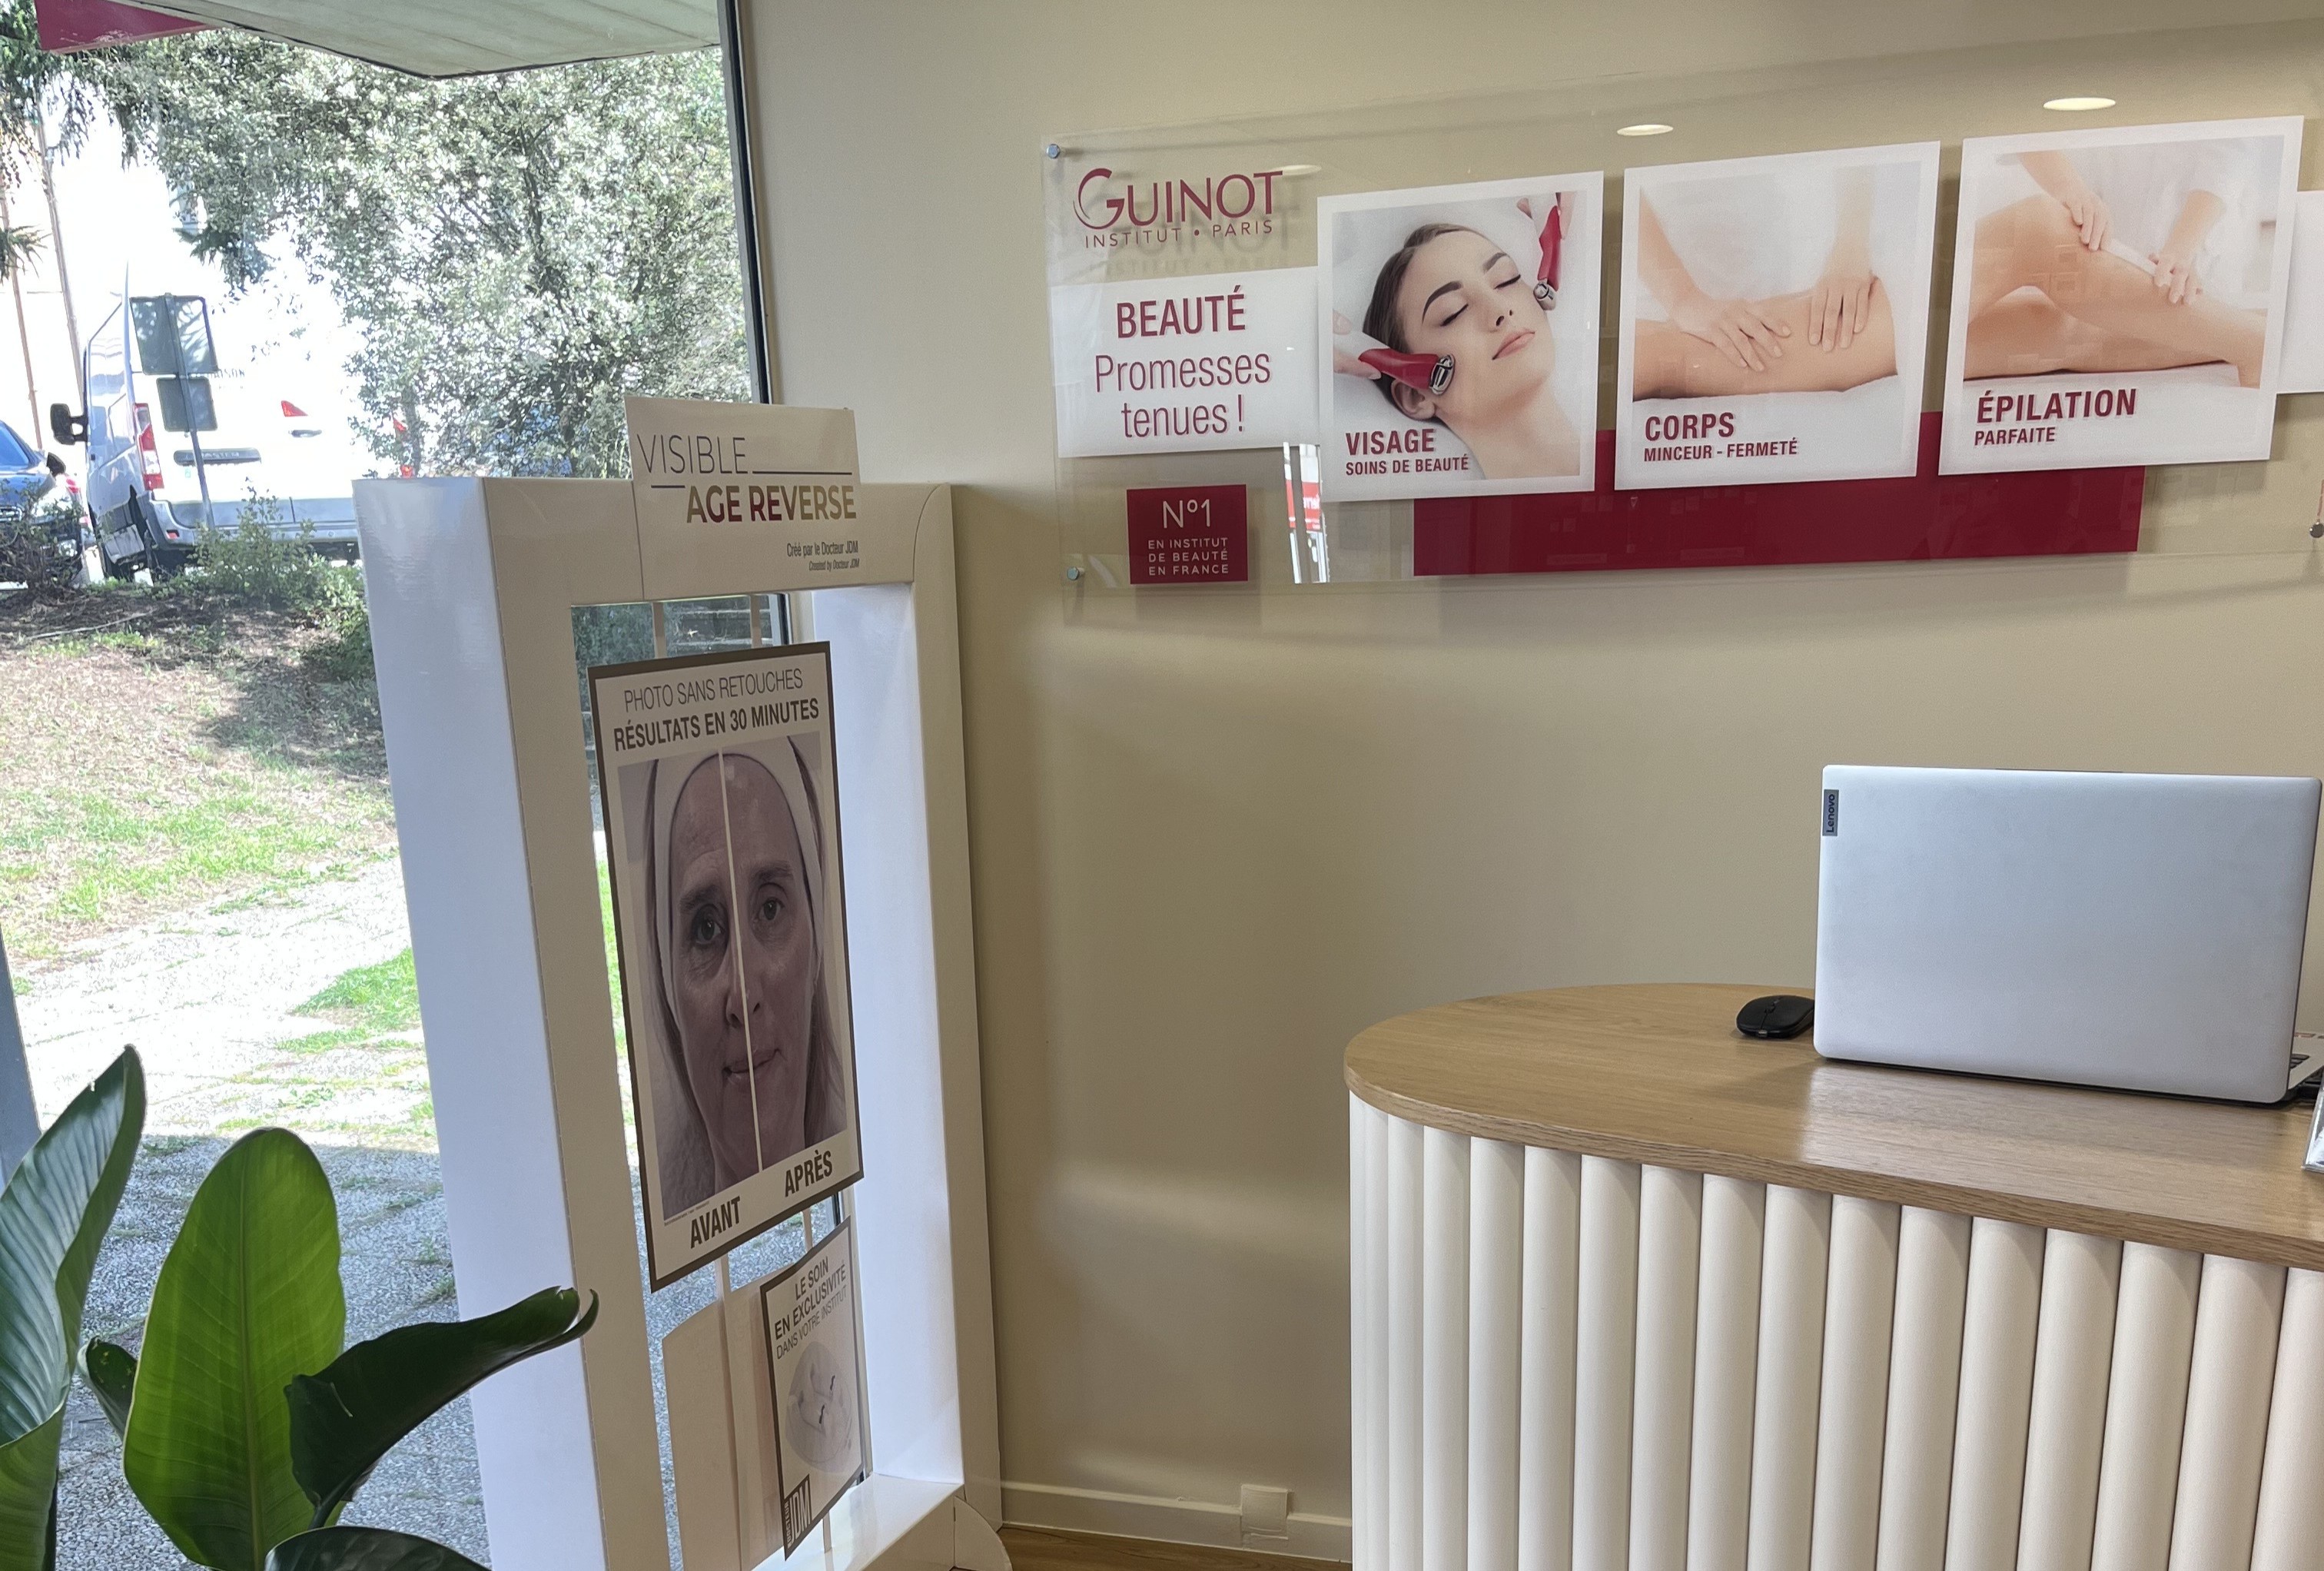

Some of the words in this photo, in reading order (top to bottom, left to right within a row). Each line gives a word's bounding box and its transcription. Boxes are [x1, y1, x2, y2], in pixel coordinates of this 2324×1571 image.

[1073, 168, 1283, 230] GUINOT
[1084, 227, 1182, 248] INSTITUT
[1212, 219, 1273, 238] PARIS
[1116, 284, 1246, 339] BEAUTÉ
[1095, 353, 1271, 393] Promesses
[1120, 402, 1228, 438] tenues
[1977, 390, 2137, 423] ÉPILATION
[1346, 428, 1435, 456] VISAGE
[1645, 412, 1735, 442] CORPS
[1974, 427, 2056, 447] PARFAITE
[636, 433, 749, 474] VISIBLE
[1346, 460, 1386, 476] SOINS
[1393, 459, 1409, 473] DE
[1416, 453, 1469, 472] BEAUTÉ
[1644, 444, 1712, 462] MINCEUR
[1727, 437, 1798, 458] FERMETÉ
[686, 485, 742, 523] AGE
[749, 485, 857, 522] REVERSE
[786, 541, 802, 557] Créé
[802, 544, 813, 559] par
[815, 542, 820, 556] le
[821, 541, 845, 555] Docteur
[845, 540, 858, 553] JDM
[1148, 540, 1164, 550] EN
[1170, 537, 1228, 549] INSTITUT
[1148, 553, 1166, 563] DE
[1173, 548, 1228, 562] BEAUTÉ
[1149, 566, 1166, 576] EN
[1173, 564, 1229, 575] FRANCE
[624, 684, 674, 712] PHOTO
[677, 679, 715, 705] SANS
[719, 668, 804, 699] RETOUCHES
[613, 715, 701, 752] RÉSULTATS
[705, 711, 726, 736] EN
[730, 708, 747, 731] 30
[751, 698, 819, 729] MINUTES
[1826, 794, 1835, 833] Lenovo
[785, 1150, 833, 1198] APRÈS
[691, 1196, 740, 1249] AVANT
[795, 1276, 807, 1300] LE
[808, 1256, 829, 1288] SOIN
[775, 1314, 791, 1340] EN
[776, 1332, 798, 1360] DANS
[798, 1310, 820, 1340] VOTRE
[822, 1284, 848, 1321] INSTITUT
[787, 1480, 811, 1549] JDM
